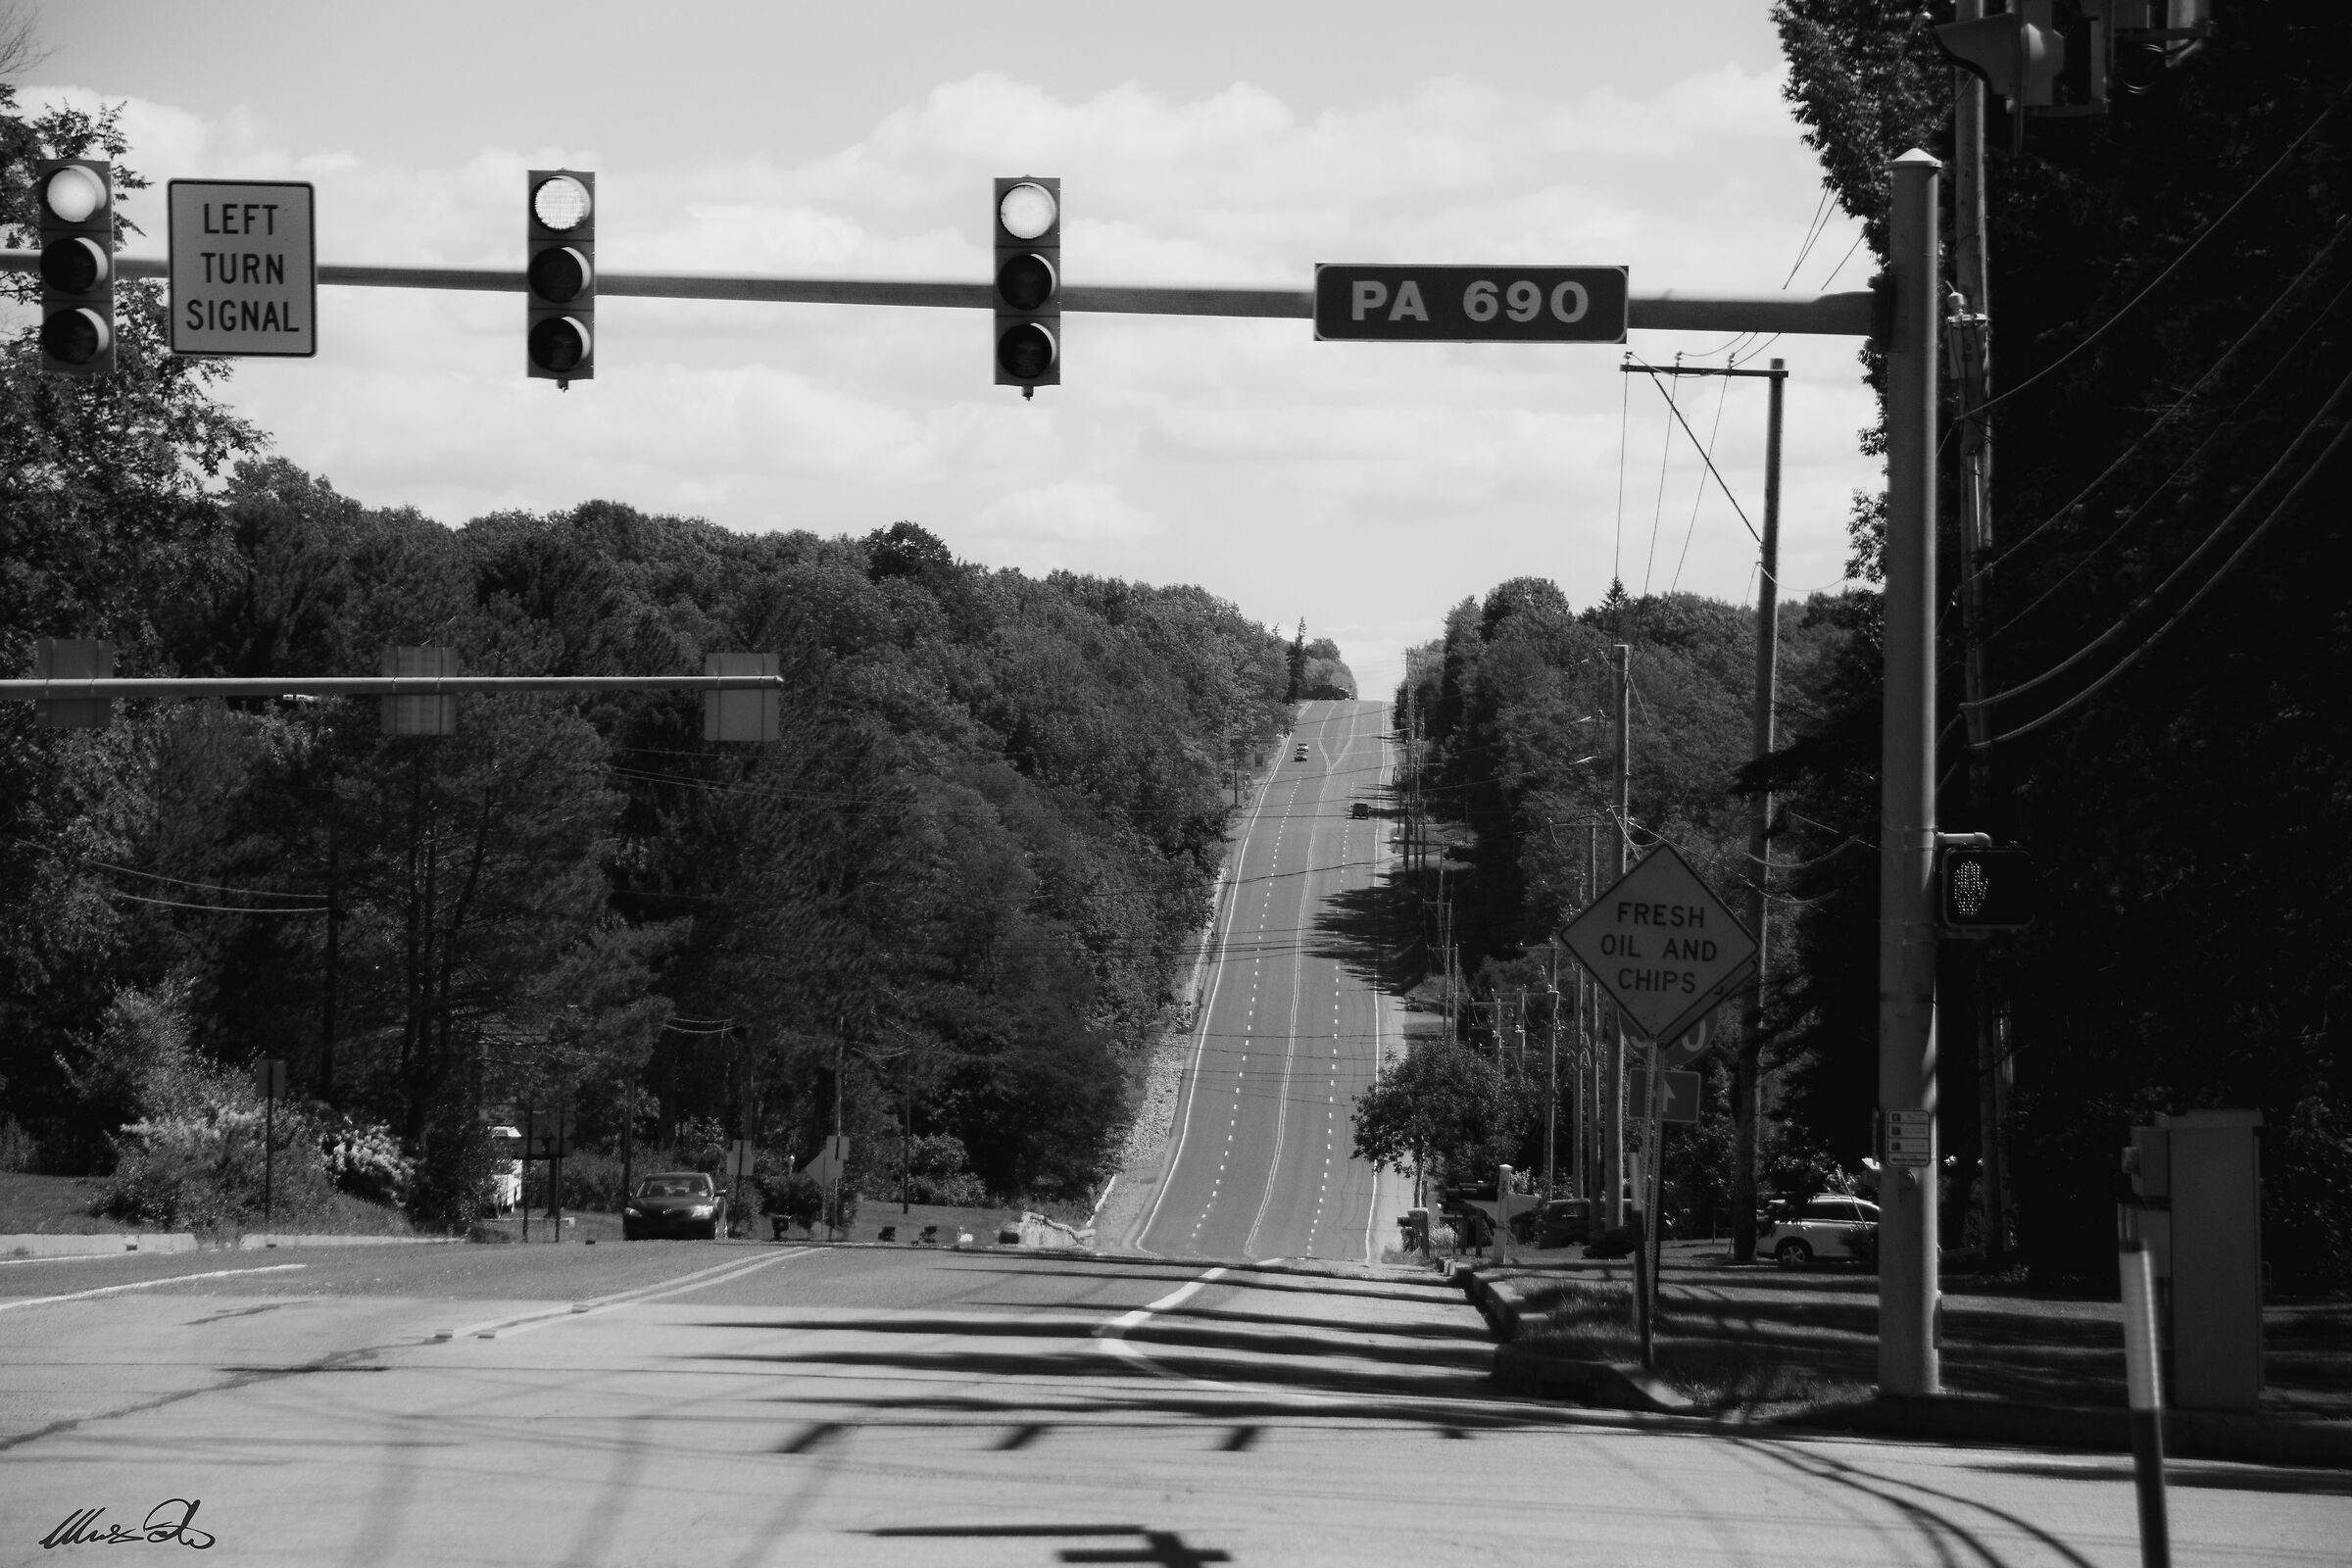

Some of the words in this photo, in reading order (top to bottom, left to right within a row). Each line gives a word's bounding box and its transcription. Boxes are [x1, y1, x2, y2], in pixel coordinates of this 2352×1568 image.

[203, 203, 279, 235] LEFT
[200, 252, 284, 284] TURN
[186, 299, 300, 332] SIGNAL
[1351, 280, 1430, 321] PA
[1463, 280, 1589, 323] 690
[1617, 902, 1705, 929] FRESH
[1600, 933, 1642, 957] OIL
[1661, 937, 1718, 962] AND
[1617, 967, 1696, 995] CHIPS
